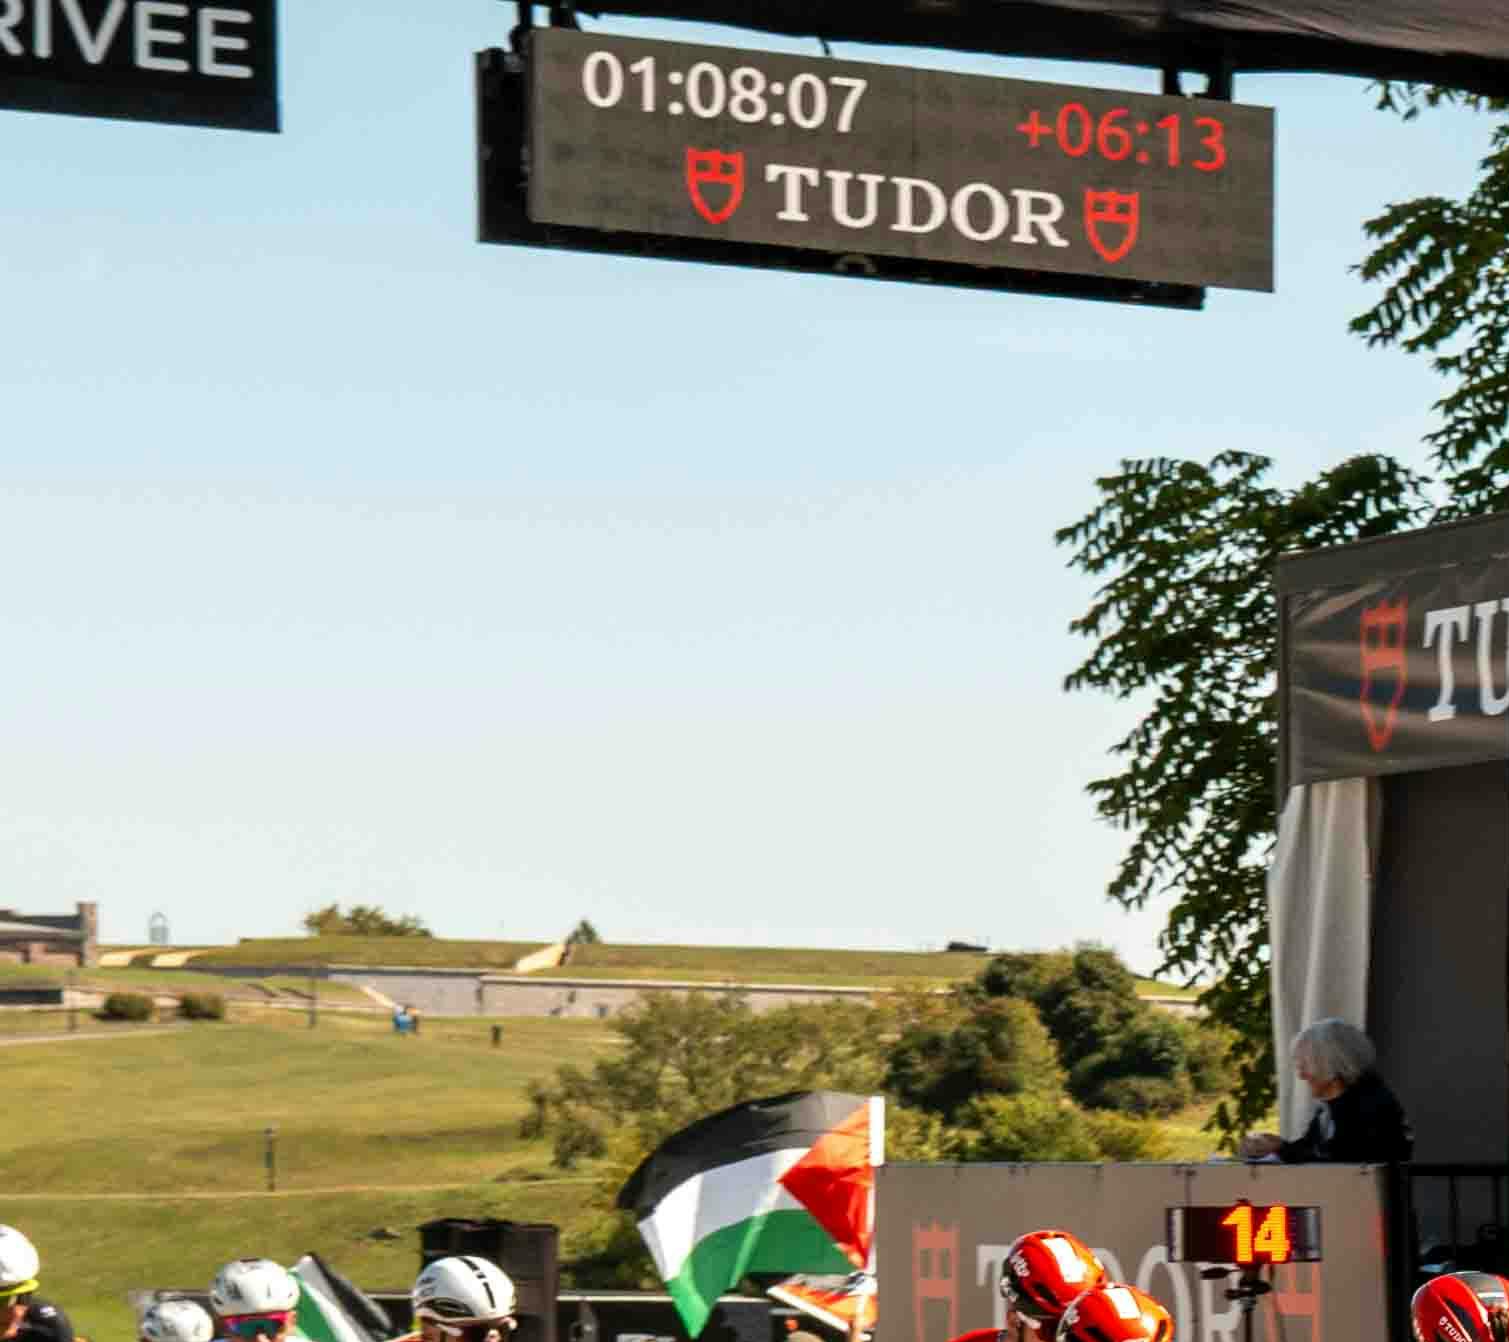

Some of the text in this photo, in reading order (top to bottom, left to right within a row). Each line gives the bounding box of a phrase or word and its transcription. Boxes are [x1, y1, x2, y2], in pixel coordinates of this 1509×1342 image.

[583, 49, 1227, 173] 01:08:07 +06:13
[763, 163, 1070, 247] TUDOR
[1223, 1204, 1291, 1263] 14
